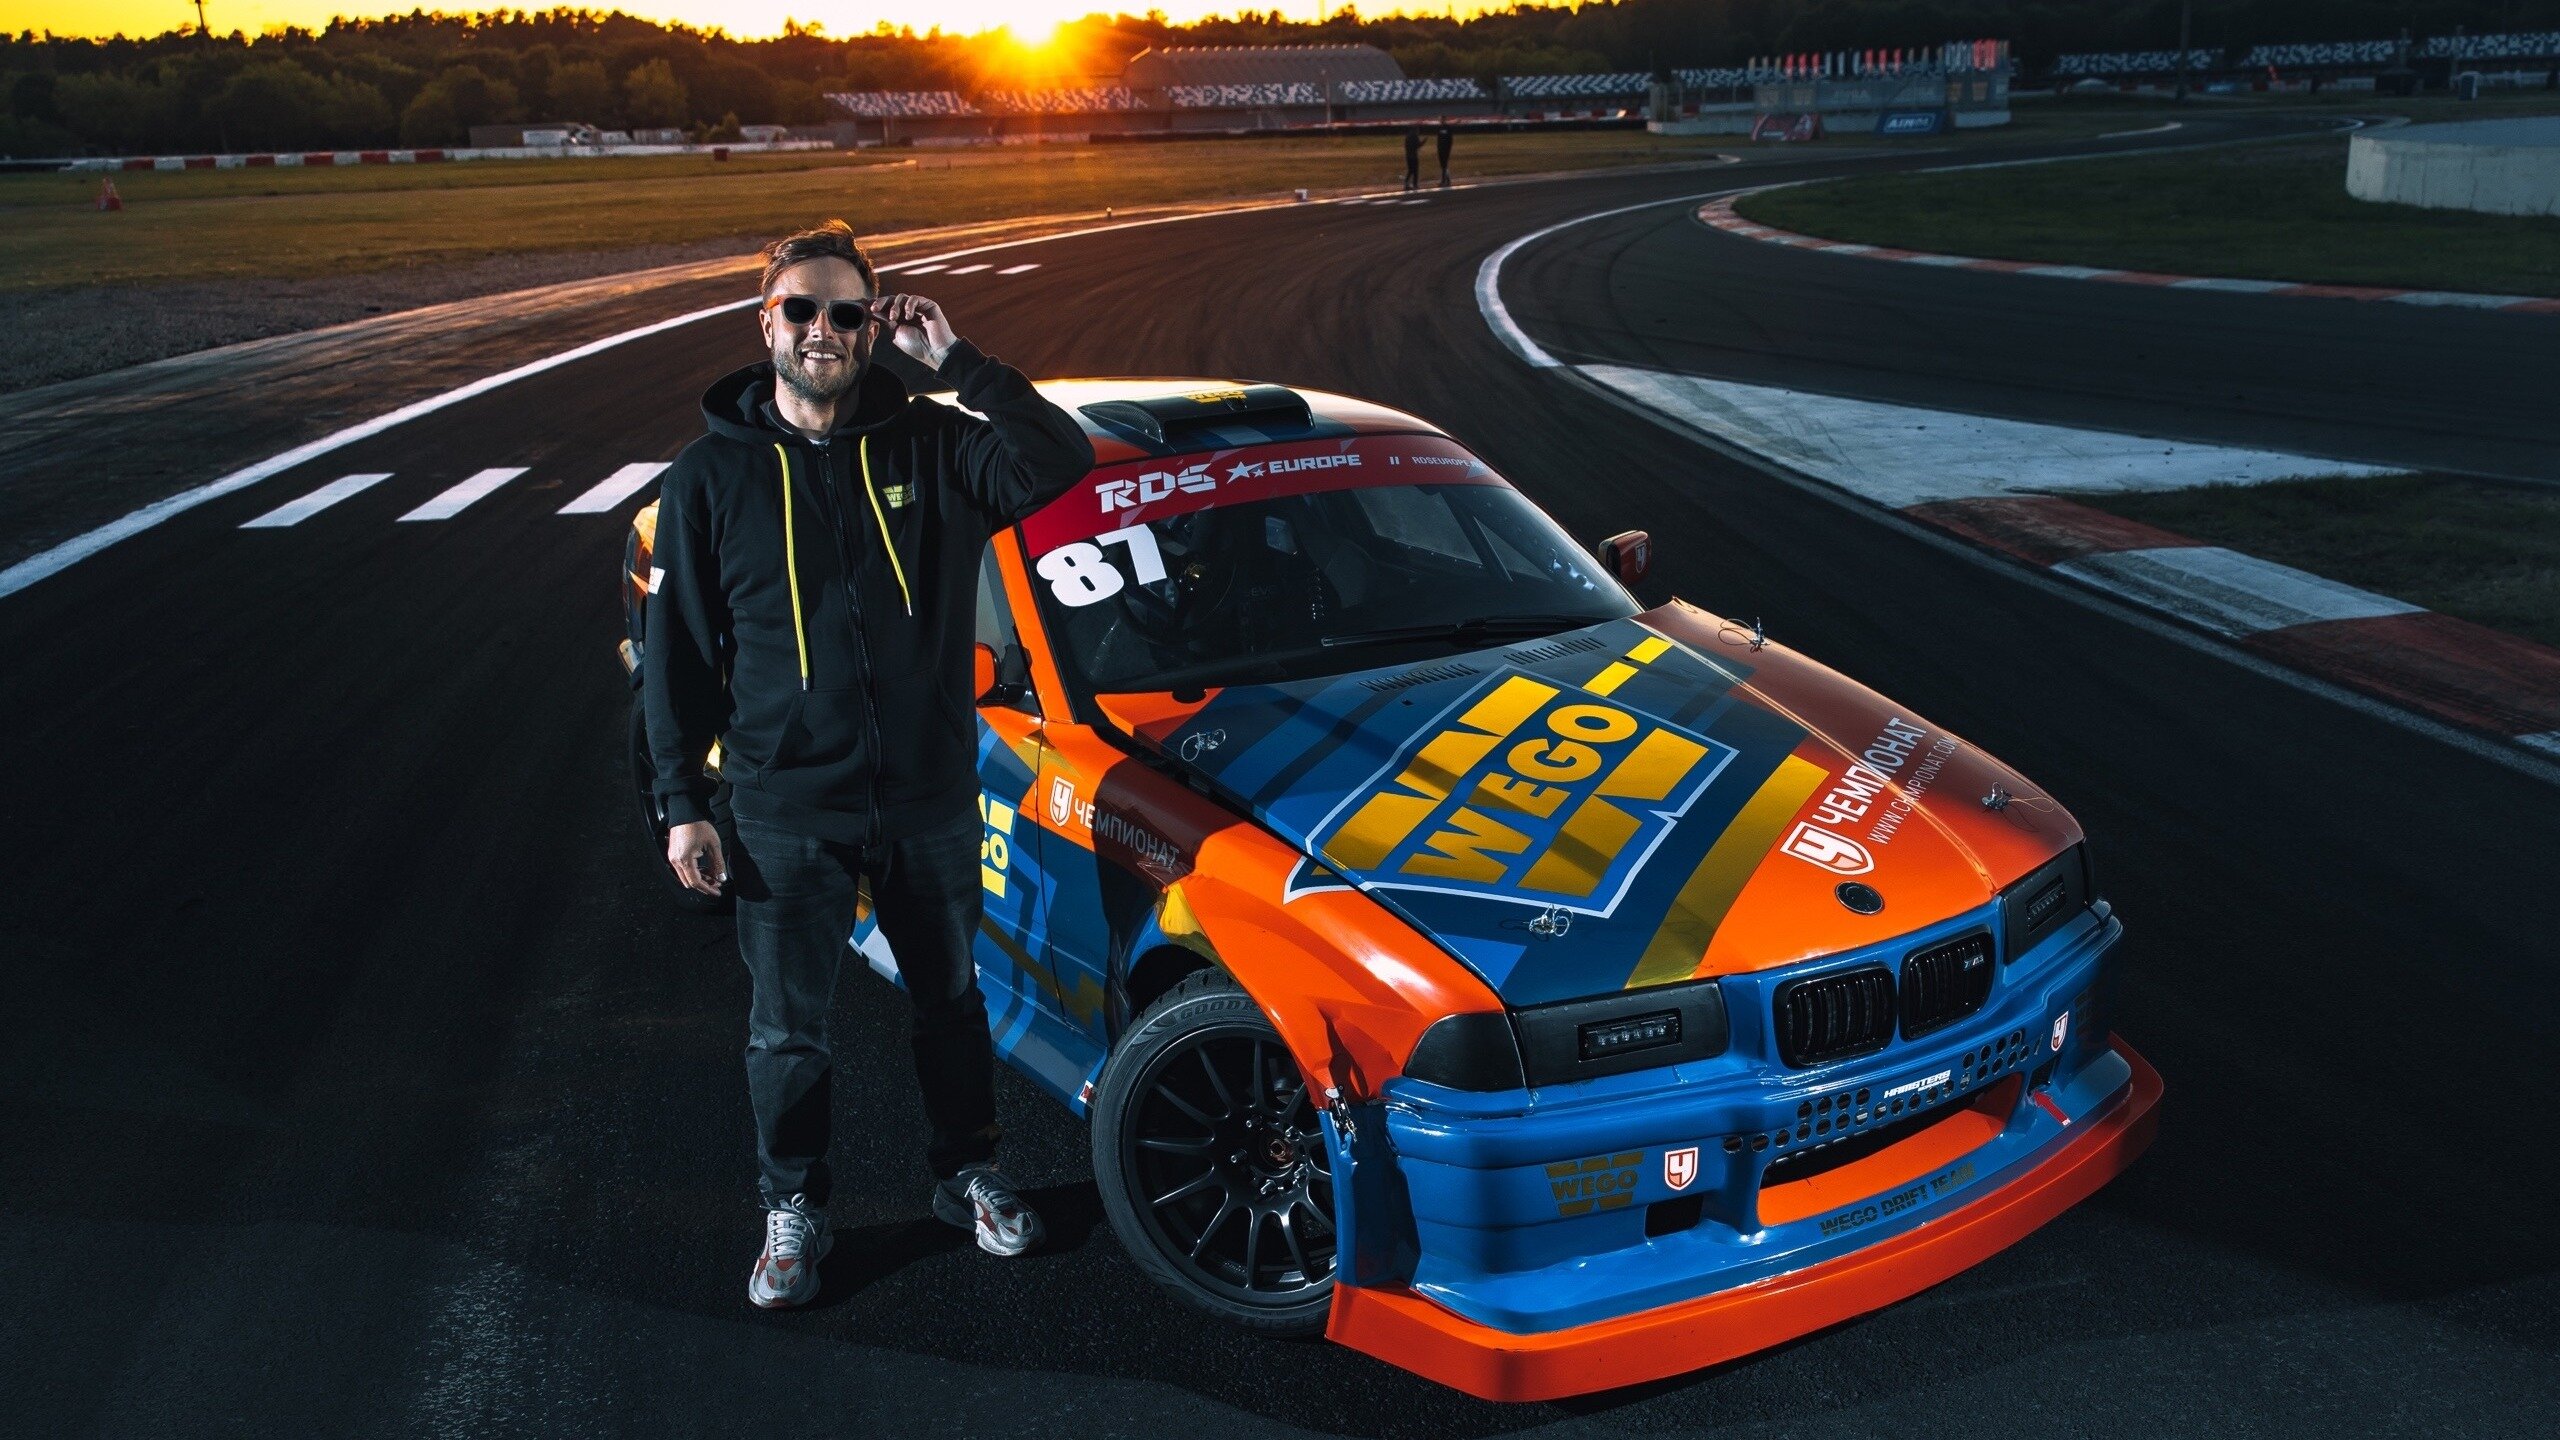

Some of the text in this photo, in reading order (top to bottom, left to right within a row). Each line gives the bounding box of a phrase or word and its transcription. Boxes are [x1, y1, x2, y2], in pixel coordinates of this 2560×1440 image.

[1095, 463, 1217, 514] RDS
[1268, 454, 1362, 473] EUROPE
[1037, 523, 1168, 607] 87
[1398, 703, 1639, 885] WEGO
[1812, 717, 1928, 823] ЧЕМПИОНАТ
[1074, 797, 1182, 868] ЧЕМПИОНАТ
[1551, 1169, 1638, 1201] WEGO
[1819, 1161, 1975, 1237] WEGO DRIFT TEAM
